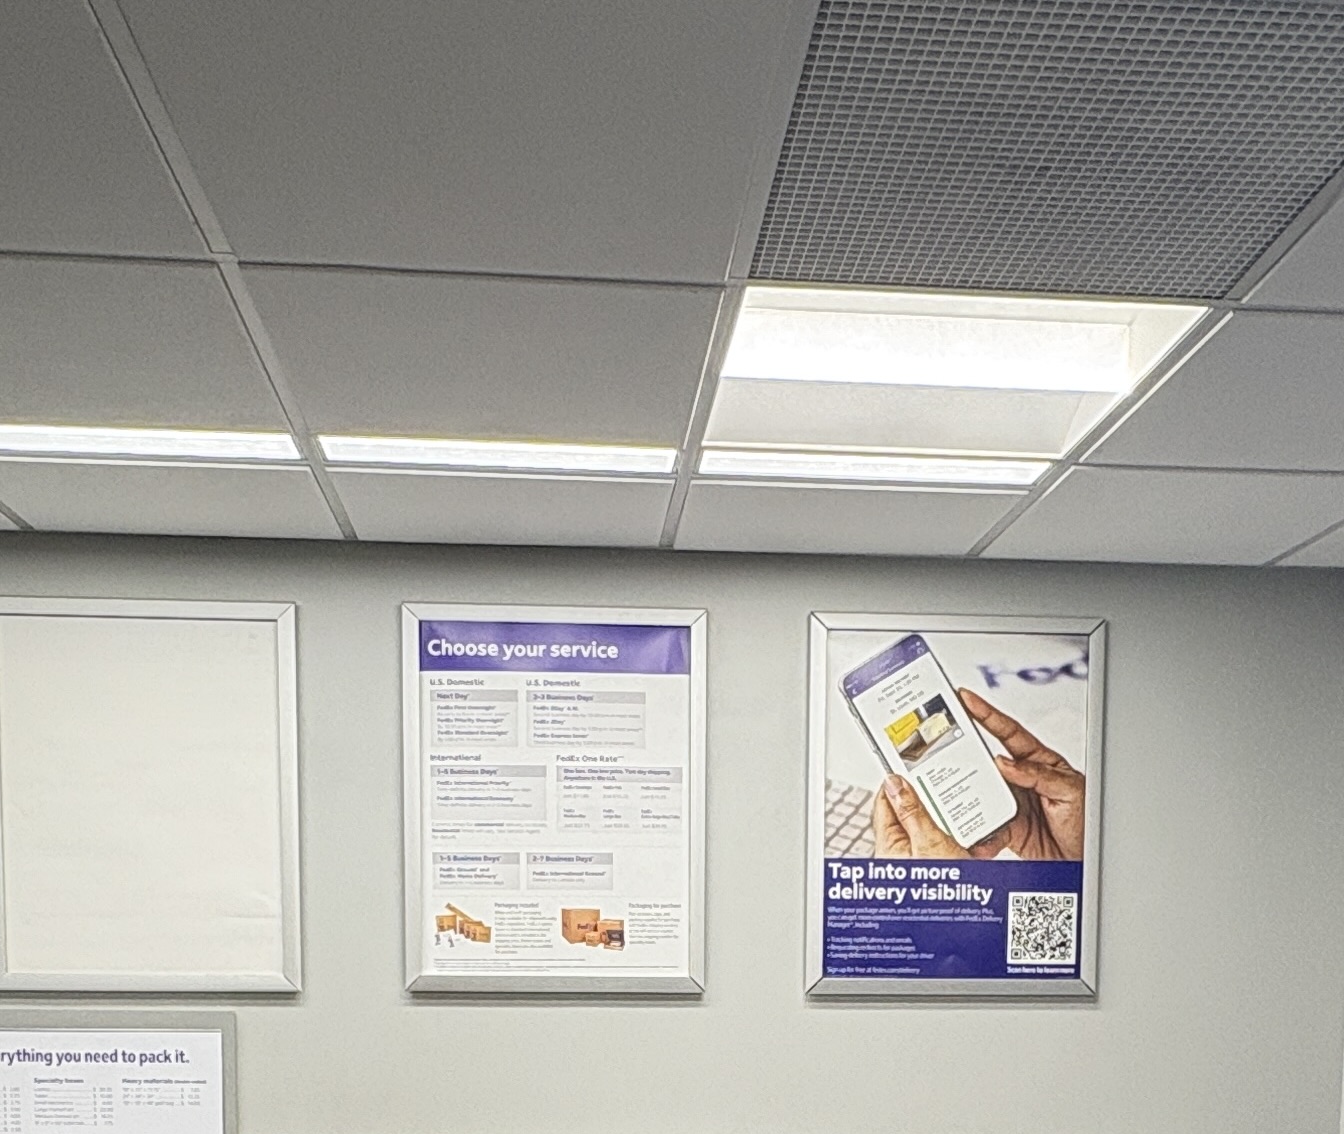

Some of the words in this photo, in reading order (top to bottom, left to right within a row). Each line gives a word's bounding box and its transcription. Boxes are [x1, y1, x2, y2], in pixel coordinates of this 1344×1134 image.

[427, 639, 499, 657] Choose
[502, 643, 547, 661] your
[550, 641, 619, 659] service
[828, 862, 864, 882] Tap
[868, 862, 906, 879] into
[910, 867, 960, 880] more
[828, 883, 906, 904] delivery
[910, 883, 993, 905] visibility
[55, 1052, 81, 1066] you
[85, 1050, 118, 1063] need
[121, 1051, 136, 1063] to
[139, 1050, 172, 1066] pack
[175, 1050, 190, 1064] it.
